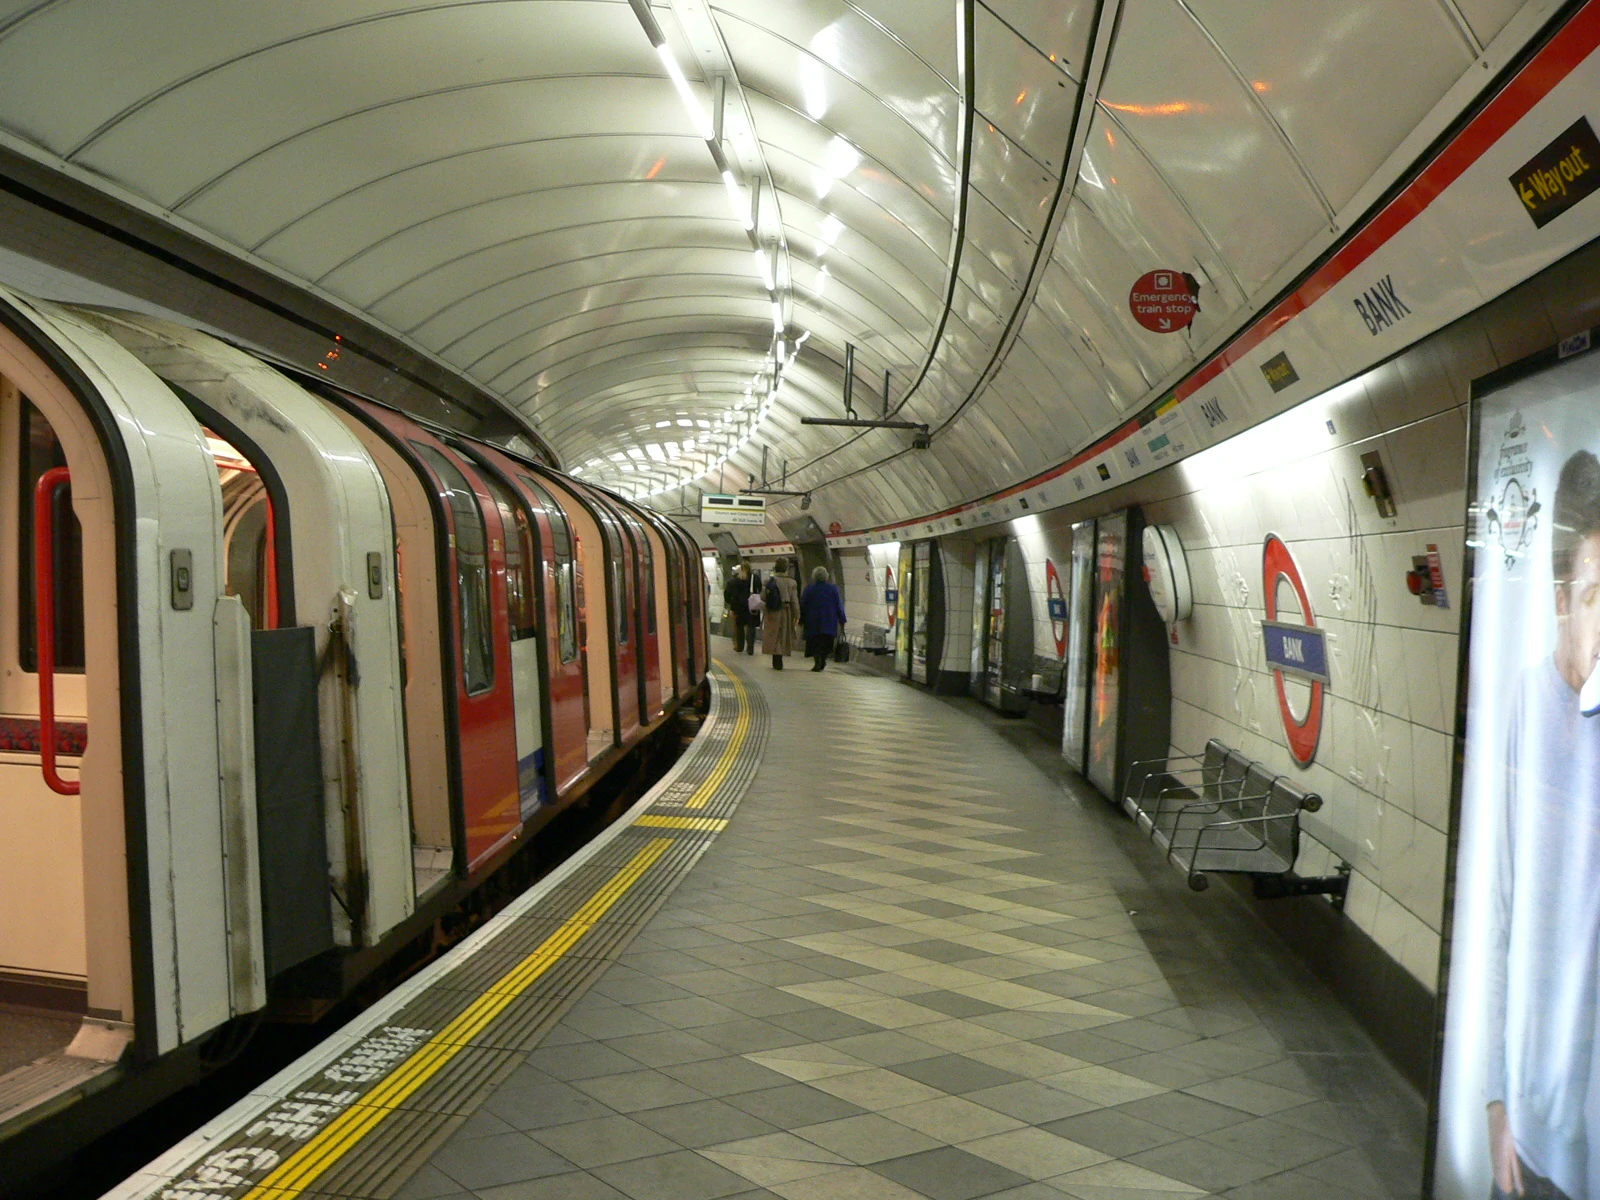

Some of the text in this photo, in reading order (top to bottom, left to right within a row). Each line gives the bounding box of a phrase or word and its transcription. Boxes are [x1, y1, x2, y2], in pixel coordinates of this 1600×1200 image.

[1527, 144, 1590, 201] Way out
[1132, 292, 1192, 304] Emergency
[1137, 304, 1192, 315] train stop
[1353, 274, 1412, 336] BANK
[1200, 396, 1229, 428] BANK
[1282, 635, 1305, 663] BANK
[245, 1091, 361, 1141] THE
